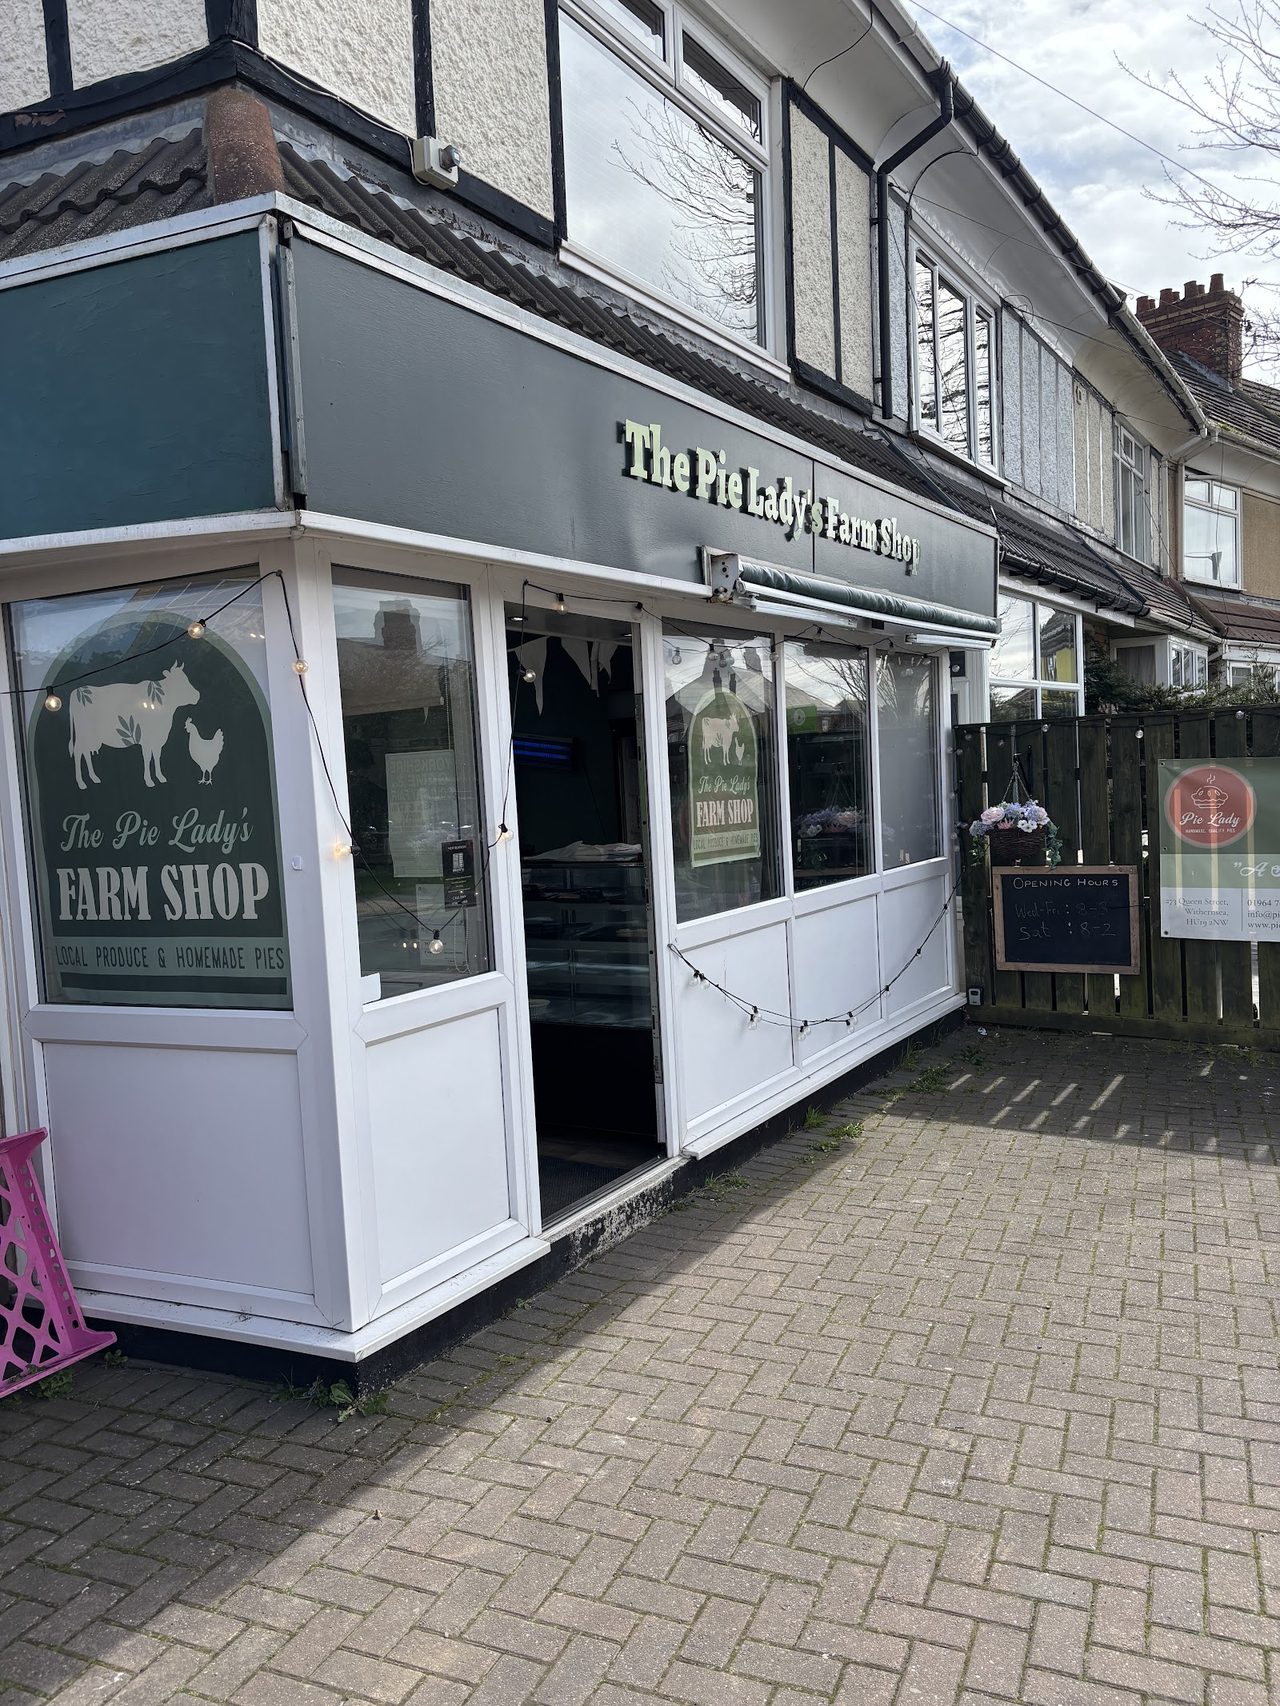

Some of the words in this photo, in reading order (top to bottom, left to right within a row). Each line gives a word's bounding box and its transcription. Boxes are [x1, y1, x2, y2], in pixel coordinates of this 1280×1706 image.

[625, 419, 690, 492] The
[696, 446, 743, 509] Pie
[747, 467, 823, 541] Lady's
[826, 496, 878, 551] Farm
[881, 517, 921, 576] Shop
[698, 776, 713, 794] The
[714, 775, 727, 793] Pie
[729, 774, 751, 795] Lady's
[696, 800, 726, 828] FARM
[728, 798, 754, 825] SHOP
[1179, 811, 1203, 826] Pie
[1207, 811, 1240, 828] Lady
[60, 813, 104, 851] The
[112, 811, 160, 850] Pie
[168, 807, 254, 854] Lady's
[56, 865, 152, 921] FARM
[160, 862, 270, 921] SHOP
[1179, 897, 1203, 906] Queen
[55, 945, 88, 967] LOCAL
[95, 946, 148, 968] PRODUCE
[157, 948, 167, 969] &
[176, 947, 246, 969] HOMEMADE
[255, 947, 285, 970] PIES
